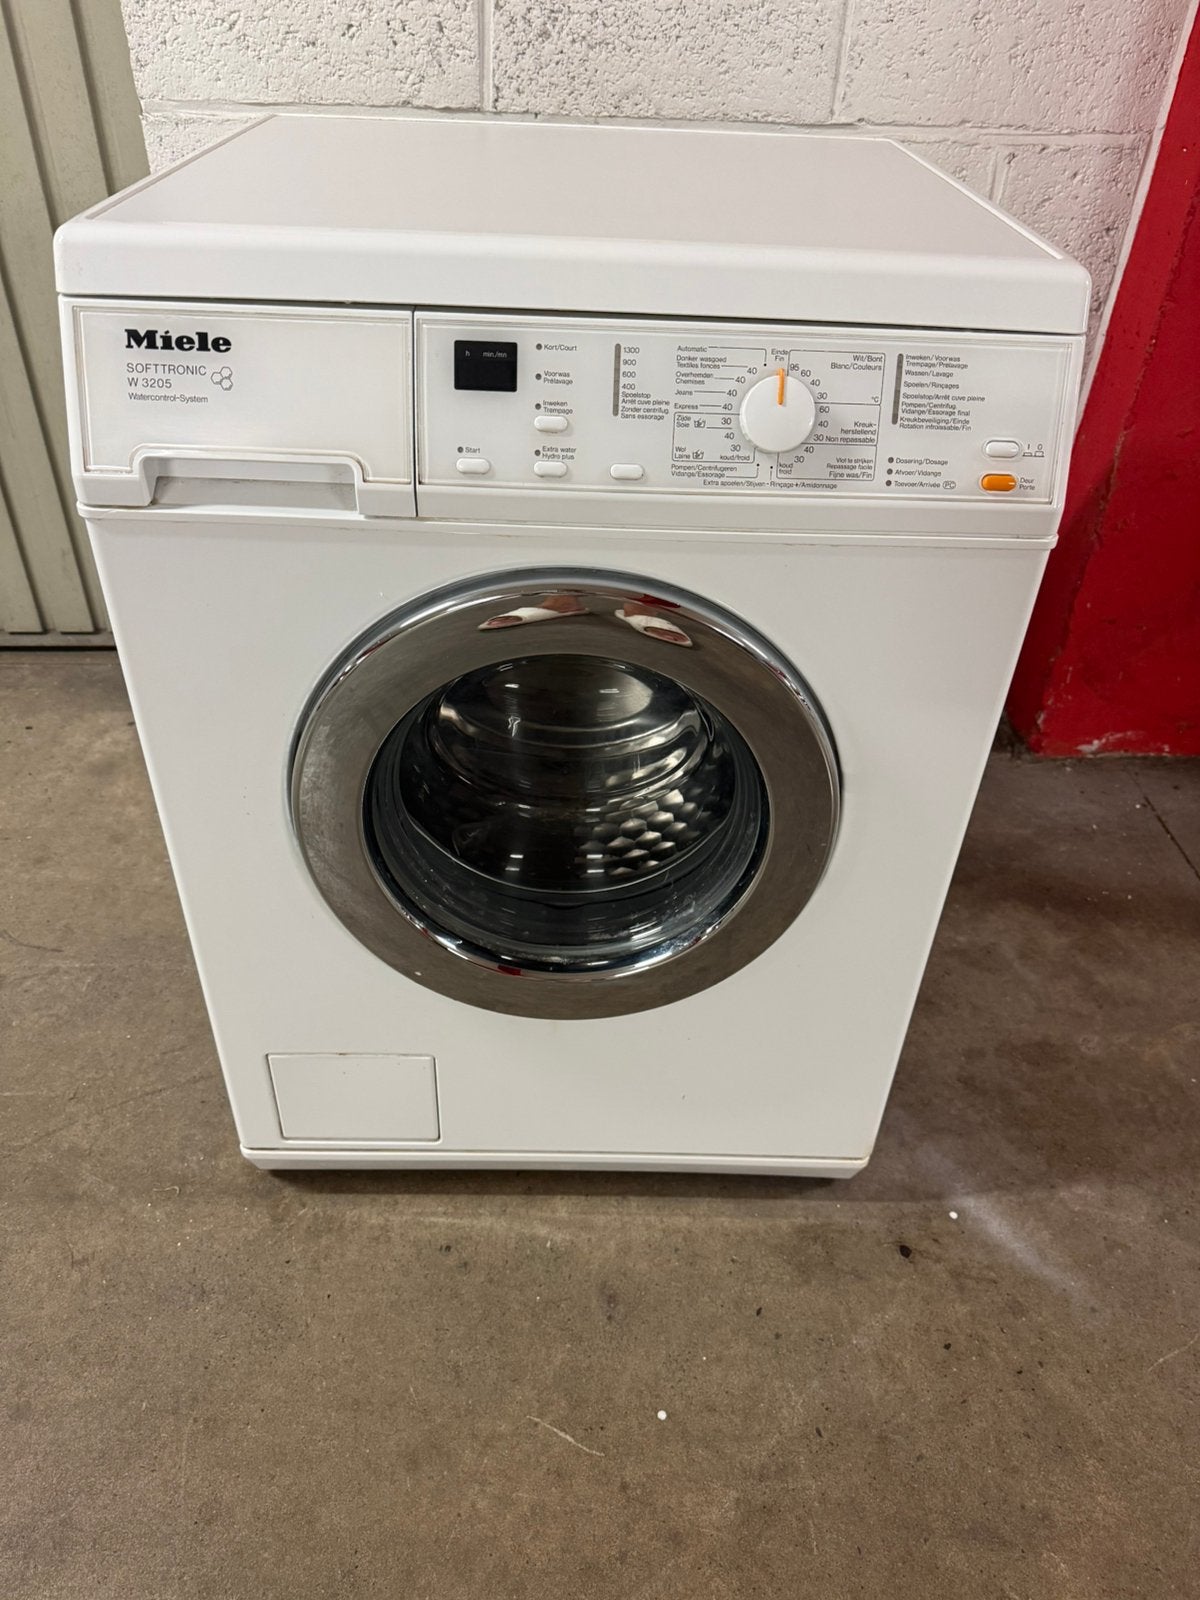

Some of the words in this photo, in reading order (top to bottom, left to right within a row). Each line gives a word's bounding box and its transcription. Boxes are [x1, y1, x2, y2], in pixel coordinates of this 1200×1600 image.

[125, 329, 232, 353] Miele
[543, 343, 577, 351] Kort/Court
[623, 346, 640, 354] 1300
[622, 358, 637, 366] 900
[853, 354, 883, 362] Wit/Bont
[905, 354, 961, 362] Inweken/Voorwas
[126, 362, 207, 376] SOFTTRONIC
[677, 361, 699, 369] Textiles
[790, 363, 800, 371] 95
[830, 361, 882, 370] Blanc/Couleurs
[543, 370, 570, 378] Voorwas
[746, 367, 758, 375] 40
[801, 369, 811, 377] 60
[904, 369, 954, 378] Wassen/Lavage
[127, 377, 139, 387] W
[142, 378, 172, 389] 3205
[543, 377, 573, 385] Prélavage
[735, 376, 746, 384] 40
[810, 379, 821, 387] 40
[903, 381, 960, 389] Spoelen/Rinçages
[621, 391, 652, 399] Spoelstop
[726, 389, 737, 397] 40
[817, 392, 828, 400] 30
[128, 392, 208, 404] Watercontrol-System
[674, 402, 699, 410] Express
[722, 403, 733, 411] 40
[543, 407, 573, 415] Trempage
[901, 408, 956, 416] Vidange/Essorage
[720, 417, 732, 425] 30
[818, 420, 829, 428] 40
[724, 432, 735, 440] 40
[813, 434, 824, 442] 30
[465, 446, 481, 454] Start
[542, 445, 559, 453] Extra
[730, 444, 741, 452] 30
[804, 446, 815, 454] 40
[541, 453, 560, 461] Hydro
[895, 457, 949, 466] Dosering/Dosage
[671, 463, 738, 472] Pompen/Centrifugeren
[826, 462, 857, 470] Repassage
[671, 471, 726, 479] Vidange/Essorage
[828, 470, 845, 479] Fijne
[846, 471, 872, 479] was/Fin
[894, 469, 942, 477] Afvoer/Vidange
